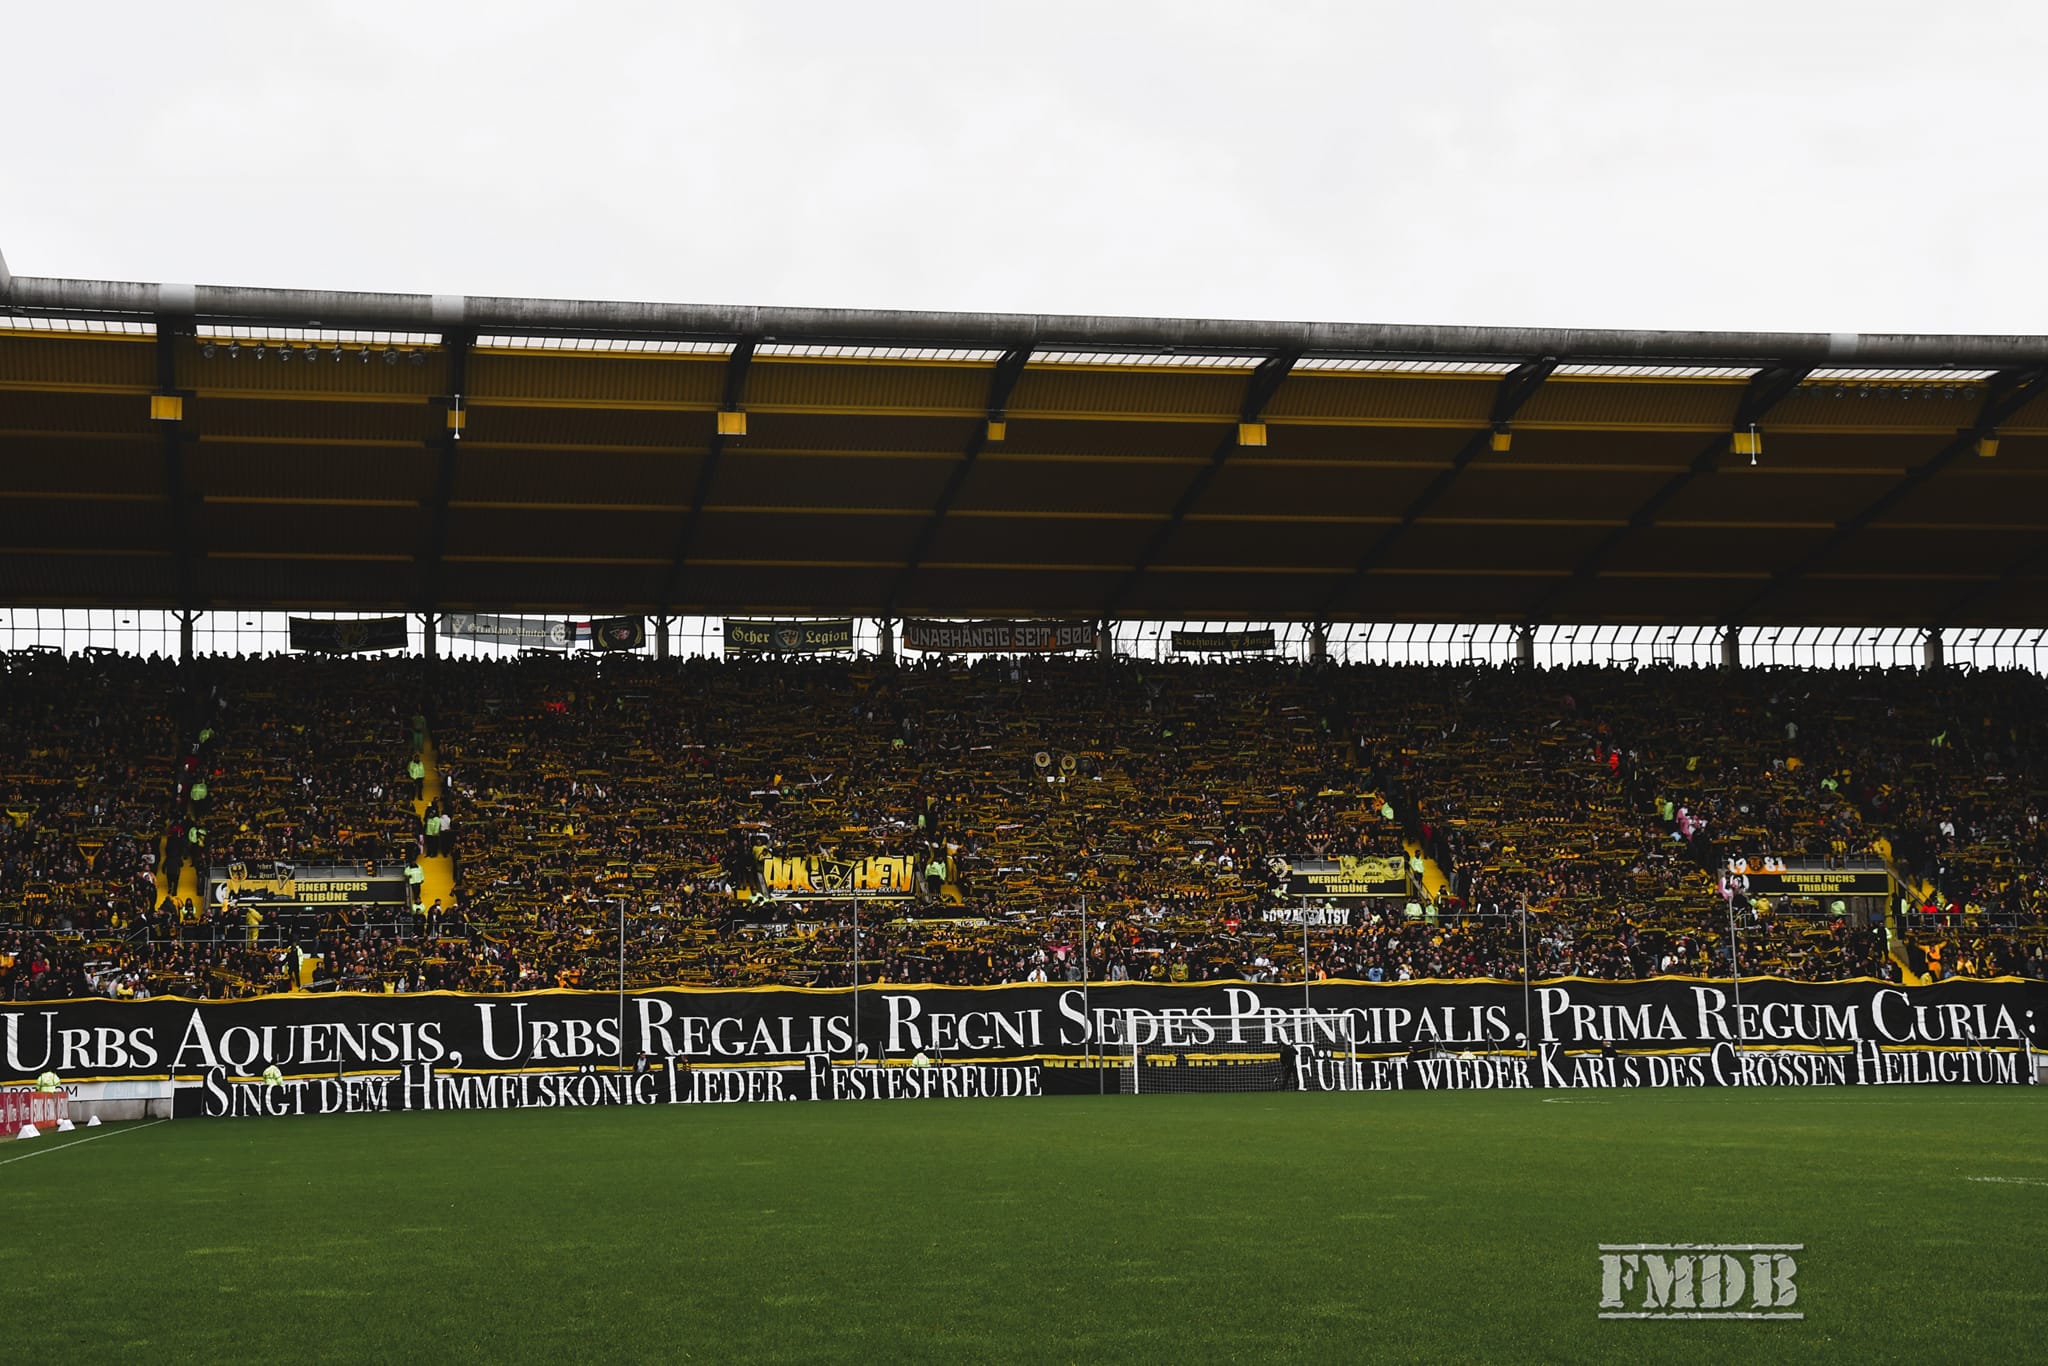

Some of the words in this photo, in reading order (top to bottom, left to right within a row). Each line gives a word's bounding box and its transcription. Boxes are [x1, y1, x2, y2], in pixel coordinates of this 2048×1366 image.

[731, 627, 770, 645] Öcher
[806, 630, 848, 645] Legion
[909, 625, 1011, 647] UNABHÄNGIG
[1015, 626, 1050, 647] SEIT
[1055, 625, 1092, 645] 1900
[294, 882, 328, 892] ERNER
[331, 882, 368, 892] FUCHS
[1781, 874, 1822, 883] WERNER
[1823, 874, 1856, 883] FUCHS
[1798, 882, 1840, 892] TRIBÜNE
[299, 891, 349, 902] TRIBÜNE
[1325, 883, 1369, 893] TRIBÜNE
[1318, 907, 1351, 925] ATSV
[1, 1011, 159, 1073] URBS
[167, 1007, 463, 1077] AQUENSIS,
[473, 1002, 622, 1062] URBS
[632, 997, 869, 1062] REGALIS,
[881, 994, 1044, 1053] REGNI
[1058, 989, 1216, 1048] SEDES
[1224, 988, 1528, 1049] PRINCIPALIS,
[1534, 987, 1687, 1042] PRIMA
[1689, 986, 1864, 1042] REGUM
[1871, 989, 2036, 1043] CURIA:
[1414, 1058, 1533, 1090] WIEDER
[1645, 1056, 1705, 1088] DES
[1711, 1041, 1847, 1086] GROSSEN
[203, 1064, 311, 1118] SINGT
[319, 1078, 391, 1114] DEM
[401, 1061, 659, 1112] HIMMELSKÖNIG
[805, 1053, 1043, 1100] FESTESFREUDE
